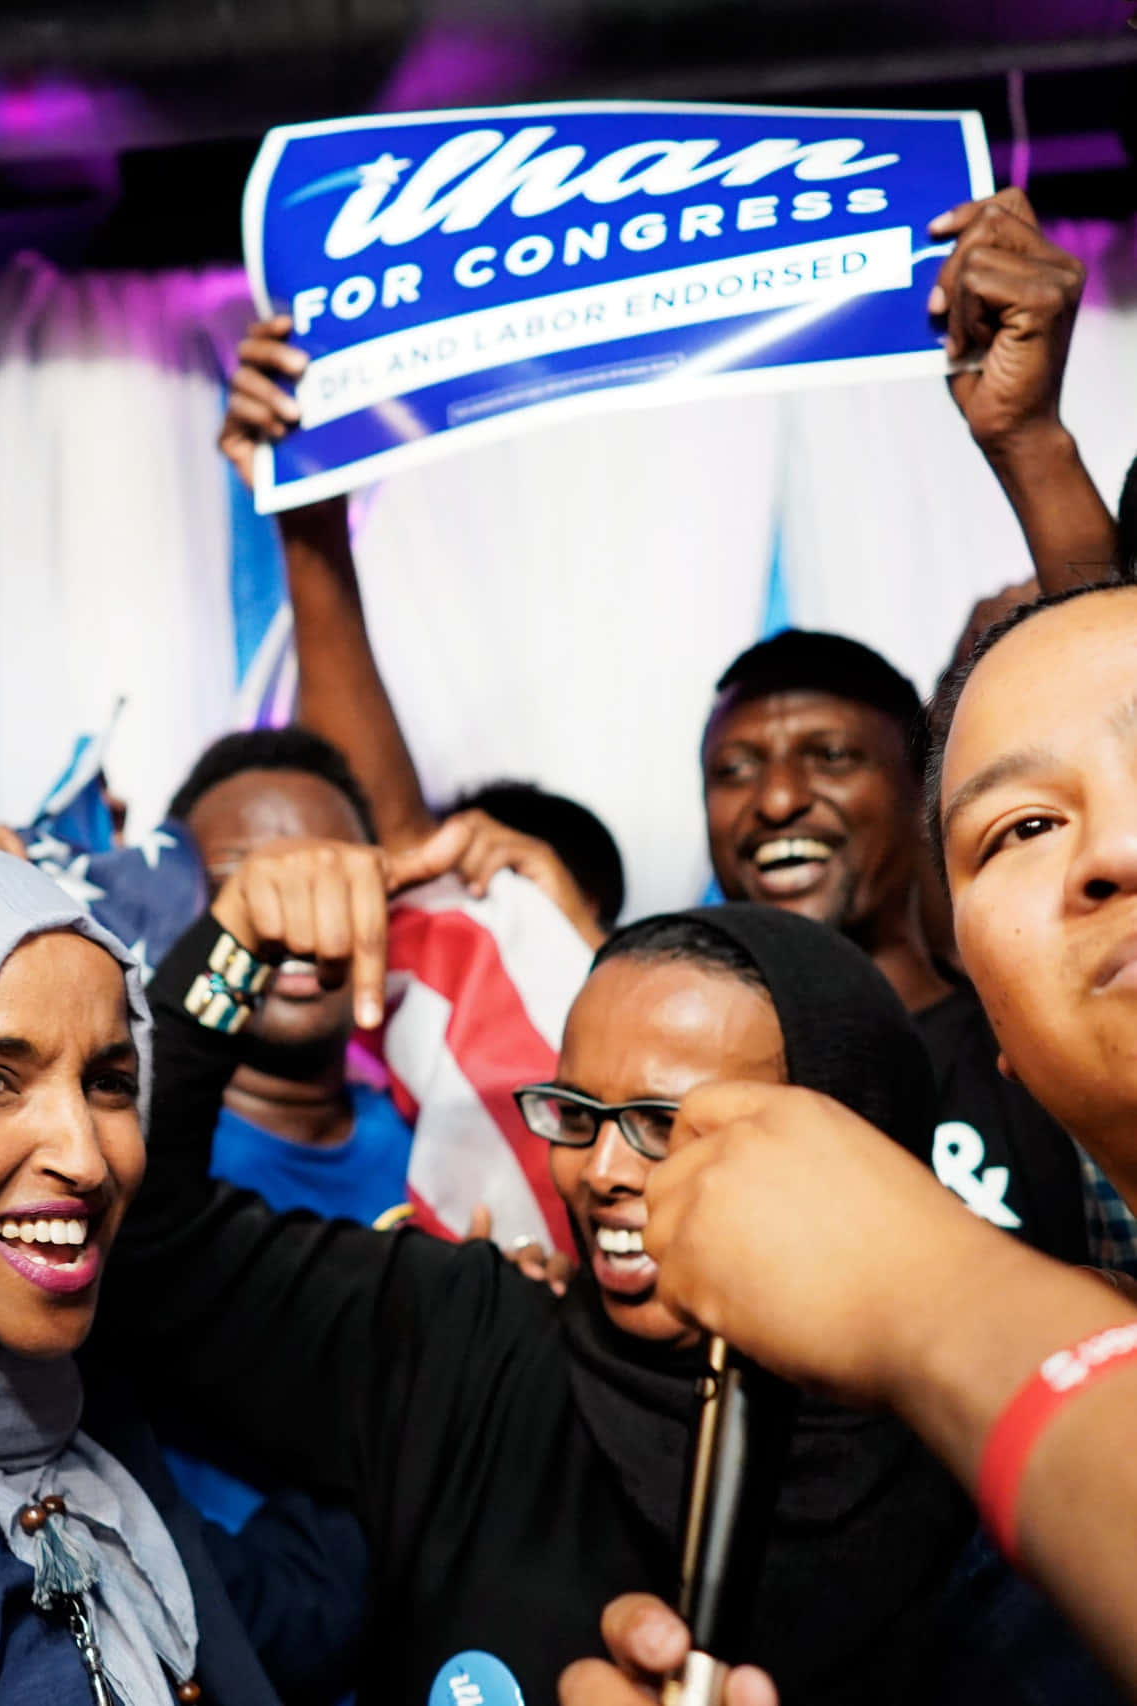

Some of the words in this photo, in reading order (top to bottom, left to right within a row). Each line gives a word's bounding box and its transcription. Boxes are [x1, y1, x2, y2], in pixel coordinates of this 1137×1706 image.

[292, 263, 422, 336] FOR
[453, 188, 889, 288] CONGRESS
[323, 125, 900, 260] ilhan
[319, 364, 374, 401] DFL
[386, 335, 459, 373] AND
[474, 300, 606, 350] LABOR
[625, 250, 868, 317] ENDORSED
